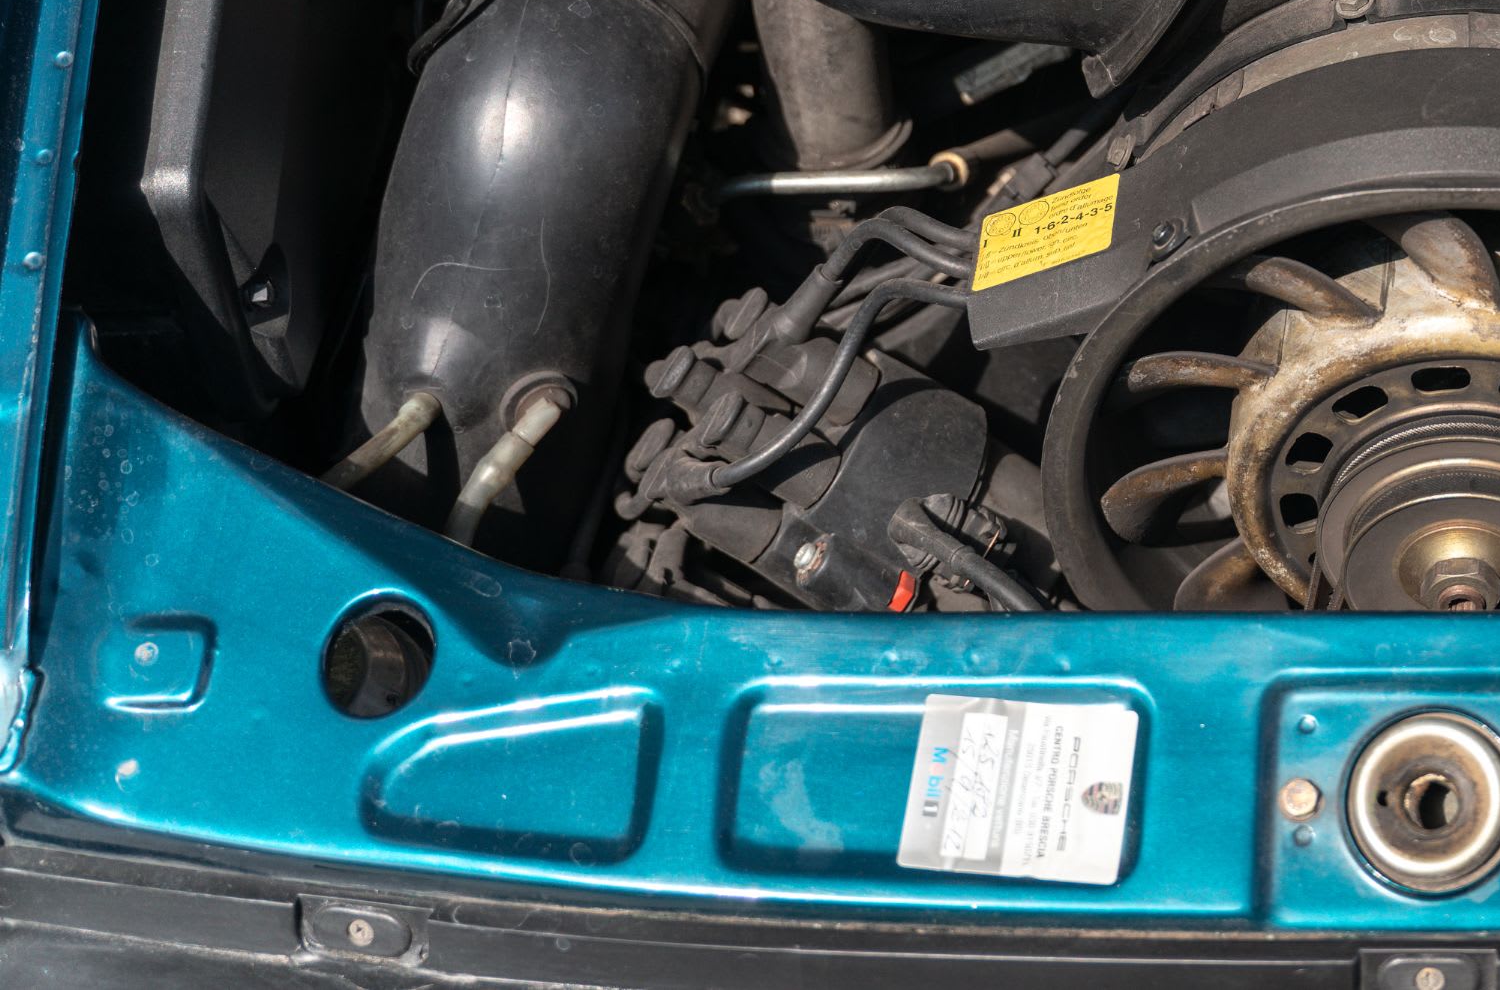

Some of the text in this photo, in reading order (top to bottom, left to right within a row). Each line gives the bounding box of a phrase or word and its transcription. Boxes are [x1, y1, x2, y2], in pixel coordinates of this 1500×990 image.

[1034, 203, 1112, 234] 1-6-2-4-3-5
[1049, 725, 1064, 764] CENTRO
[924, 746, 949, 798] Mobil
[1042, 767, 1058, 812] PORSCHE
[1056, 736, 1081, 851] PORSCHE
[1035, 815, 1051, 858] BRESCIA
